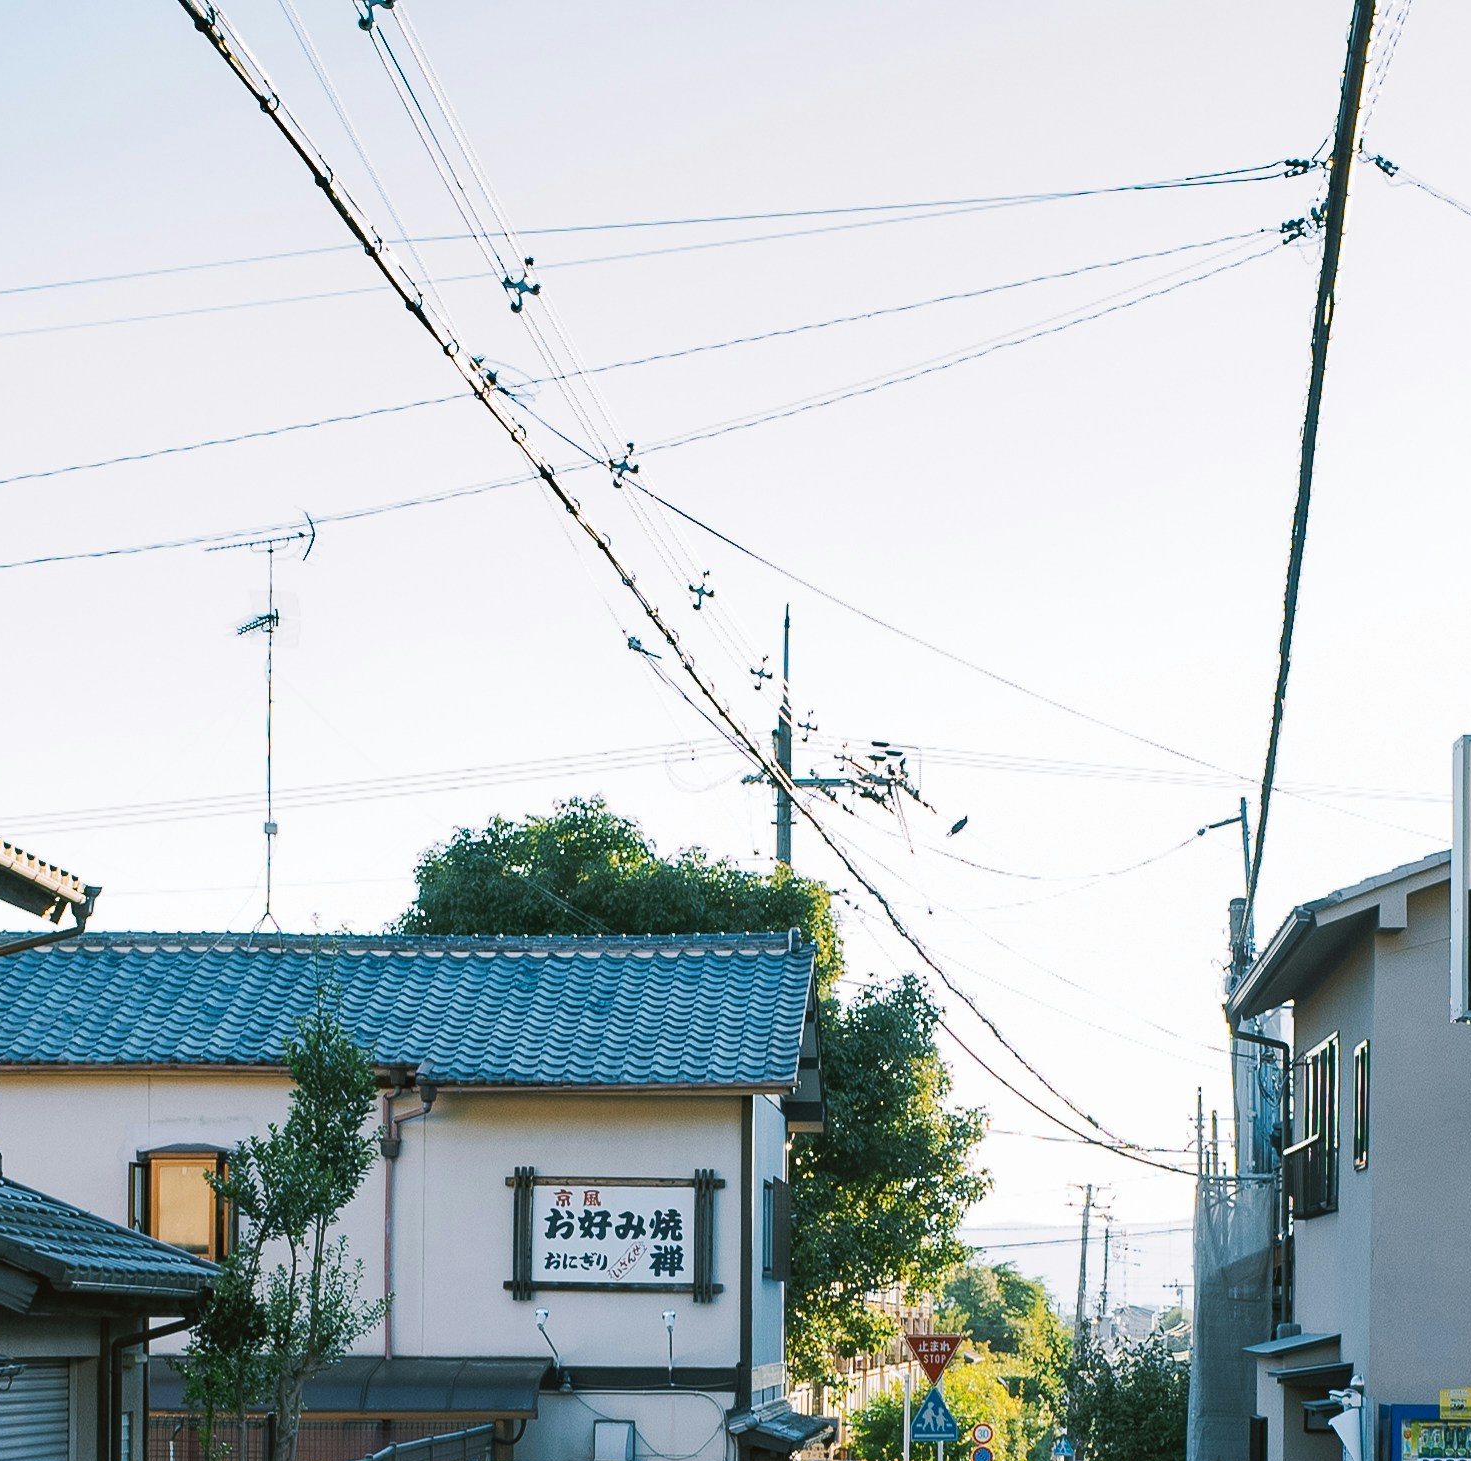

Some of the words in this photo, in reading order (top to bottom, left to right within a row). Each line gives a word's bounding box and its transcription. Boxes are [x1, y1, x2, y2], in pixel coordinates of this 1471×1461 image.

[553, 1189, 602, 1207] 京風
[544, 1207, 684, 1242] お好み焼
[544, 1251, 609, 1271] おにぎり
[917, 1340, 952, 1353] 止まれ
[923, 1354, 947, 1364] STOP
[977, 1428, 990, 1440] 30
